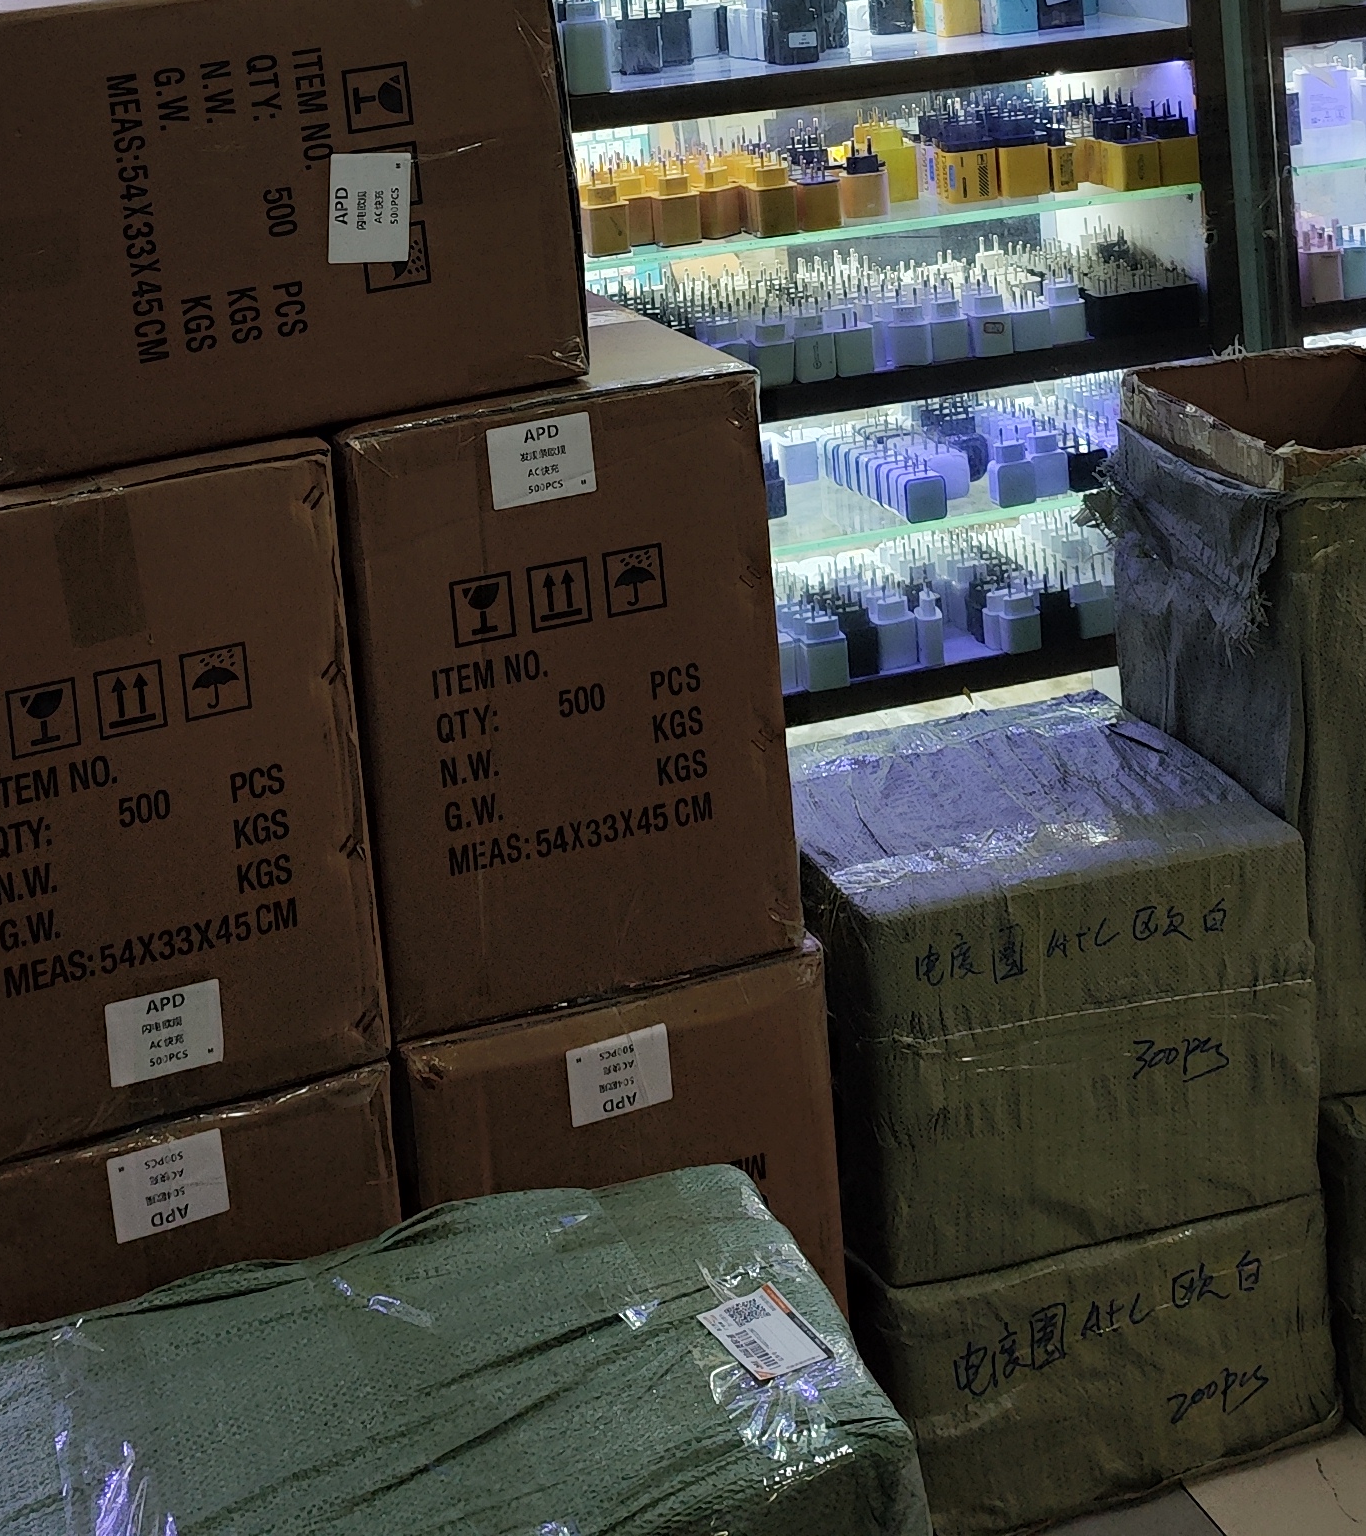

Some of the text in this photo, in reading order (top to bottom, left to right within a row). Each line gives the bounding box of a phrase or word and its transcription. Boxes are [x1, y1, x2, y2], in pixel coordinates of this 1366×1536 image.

[292, 47, 334, 171] ITEM NO.
[153, 67, 217, 353] G.W. KGS
[199, 60, 263, 345] N.W. KGS
[246, 54, 309, 338] QTY: 500 PCS
[334, 187, 349, 225] APD
[390, 187, 400, 225] 500PCS
[523, 424, 560, 444] APD
[528, 479, 564, 494] 500PCS
[431, 650, 549, 700] ITEM NO.
[436, 663, 701, 743] QTY: 500 PCS
[439, 706, 704, 789] N.W. KGS
[68, 755, 119, 794] NO.
[444, 749, 708, 832] G.W. KGS
[118, 789, 171, 828] 500
[230, 763, 285, 804] PCS
[233, 808, 290, 850] KGS
[236, 853, 293, 895] KGS
[145, 992, 186, 1015] APD
[149, 1049, 189, 1067] 500PCS
[598, 1044, 635, 1062] 500PCS
[602, 1091, 637, 1113] APD
[144, 1151, 184, 1170] 500PCS
[150, 1203, 190, 1228] APD
